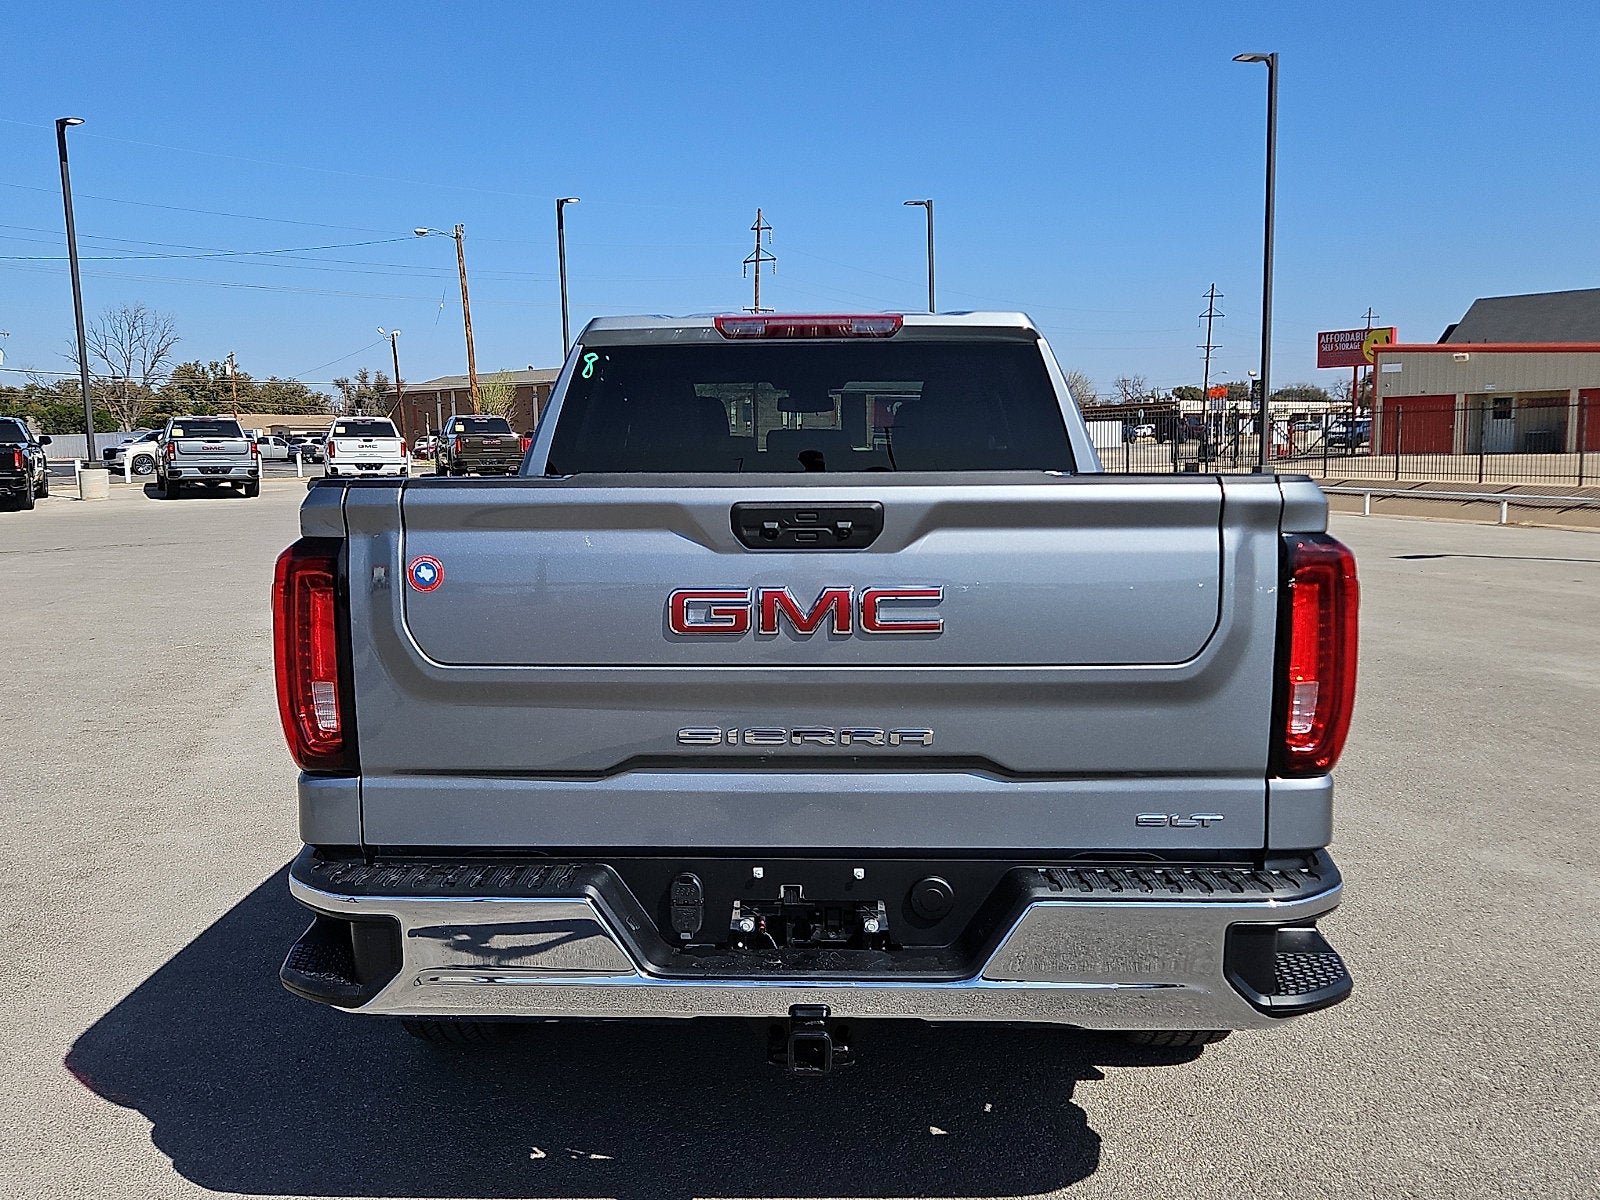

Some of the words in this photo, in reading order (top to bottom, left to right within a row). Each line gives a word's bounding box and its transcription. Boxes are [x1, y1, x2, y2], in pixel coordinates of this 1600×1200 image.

[1320, 331, 1369, 344] AFFORDABLE
[1321, 343, 1334, 352] SELF
[1334, 341, 1361, 351] STORAGE
[667, 586, 944, 635] GMC
[677, 727, 934, 746] SIERRA
[1135, 813, 1224, 828] SLT
